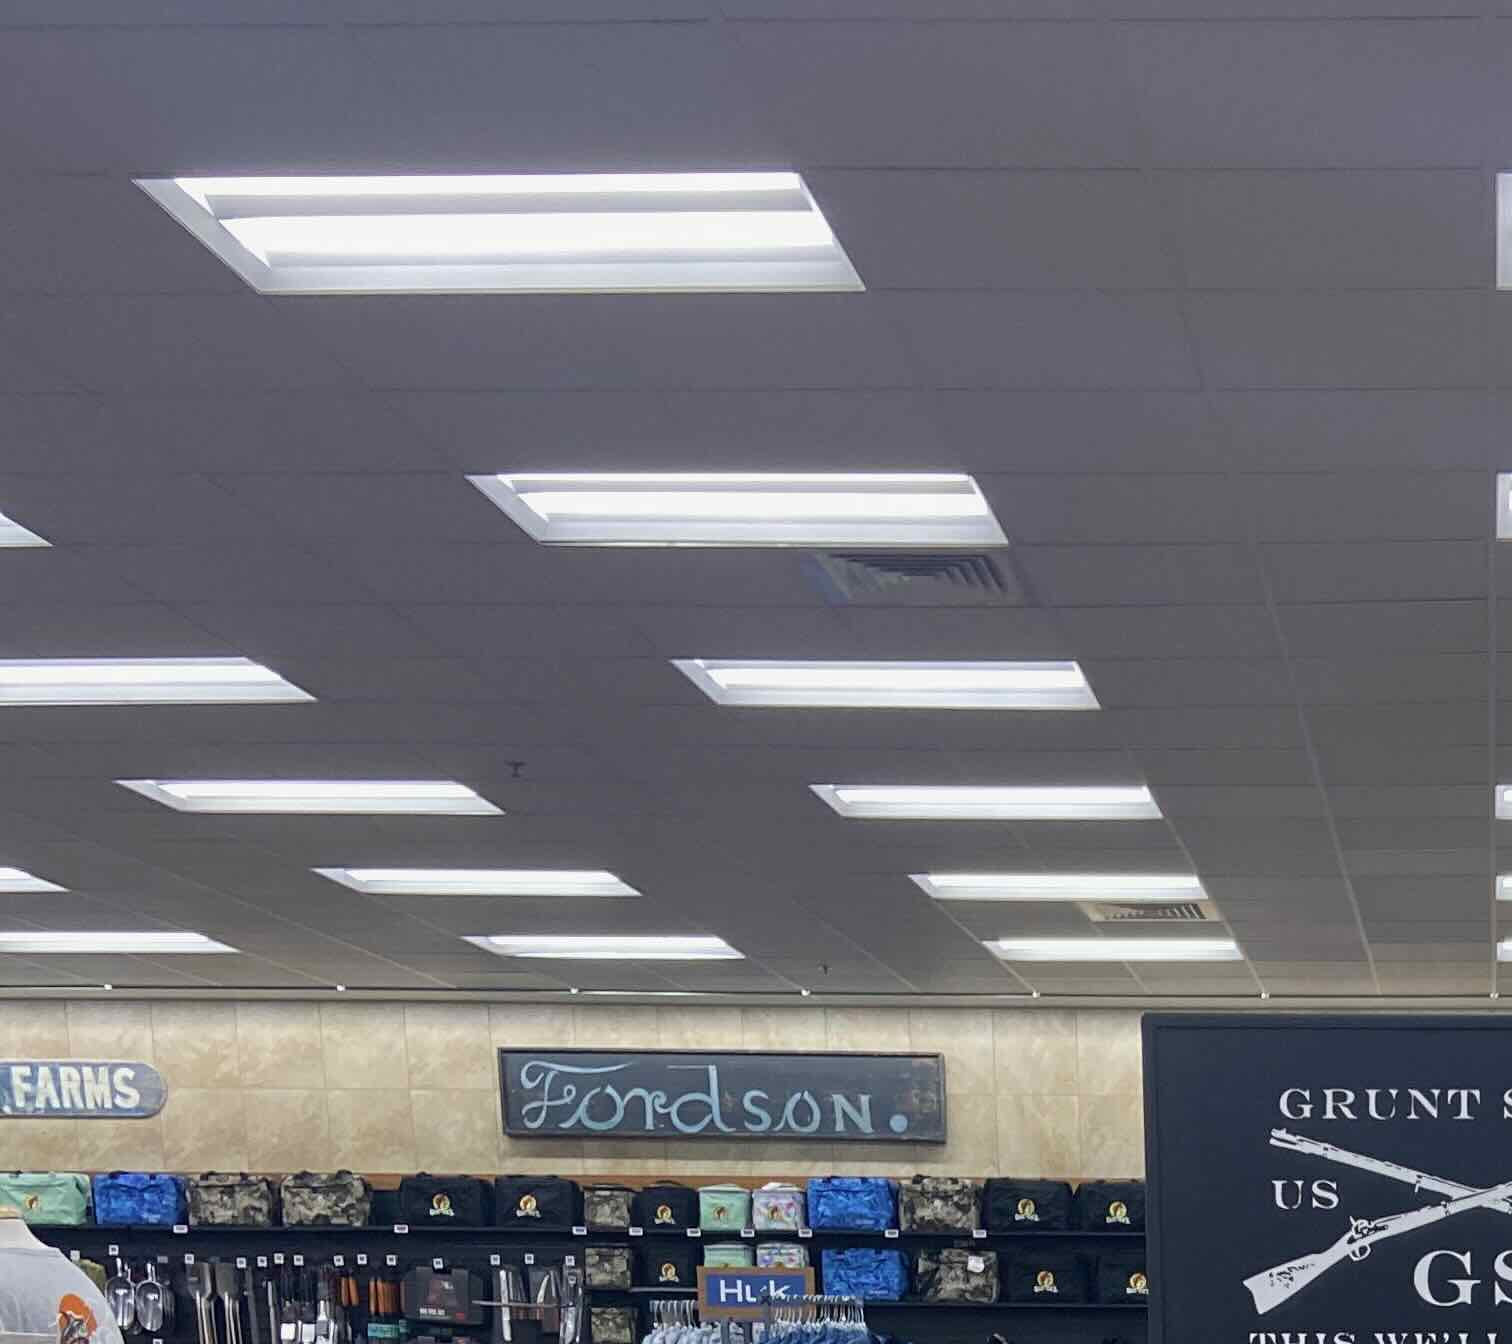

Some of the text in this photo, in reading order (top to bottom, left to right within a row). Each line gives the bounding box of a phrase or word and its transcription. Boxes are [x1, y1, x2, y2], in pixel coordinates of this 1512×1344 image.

[11, 1065, 140, 1109] FARMS
[1279, 1088, 1480, 1120] GRUNT
[1271, 1180, 1340, 1209] US
